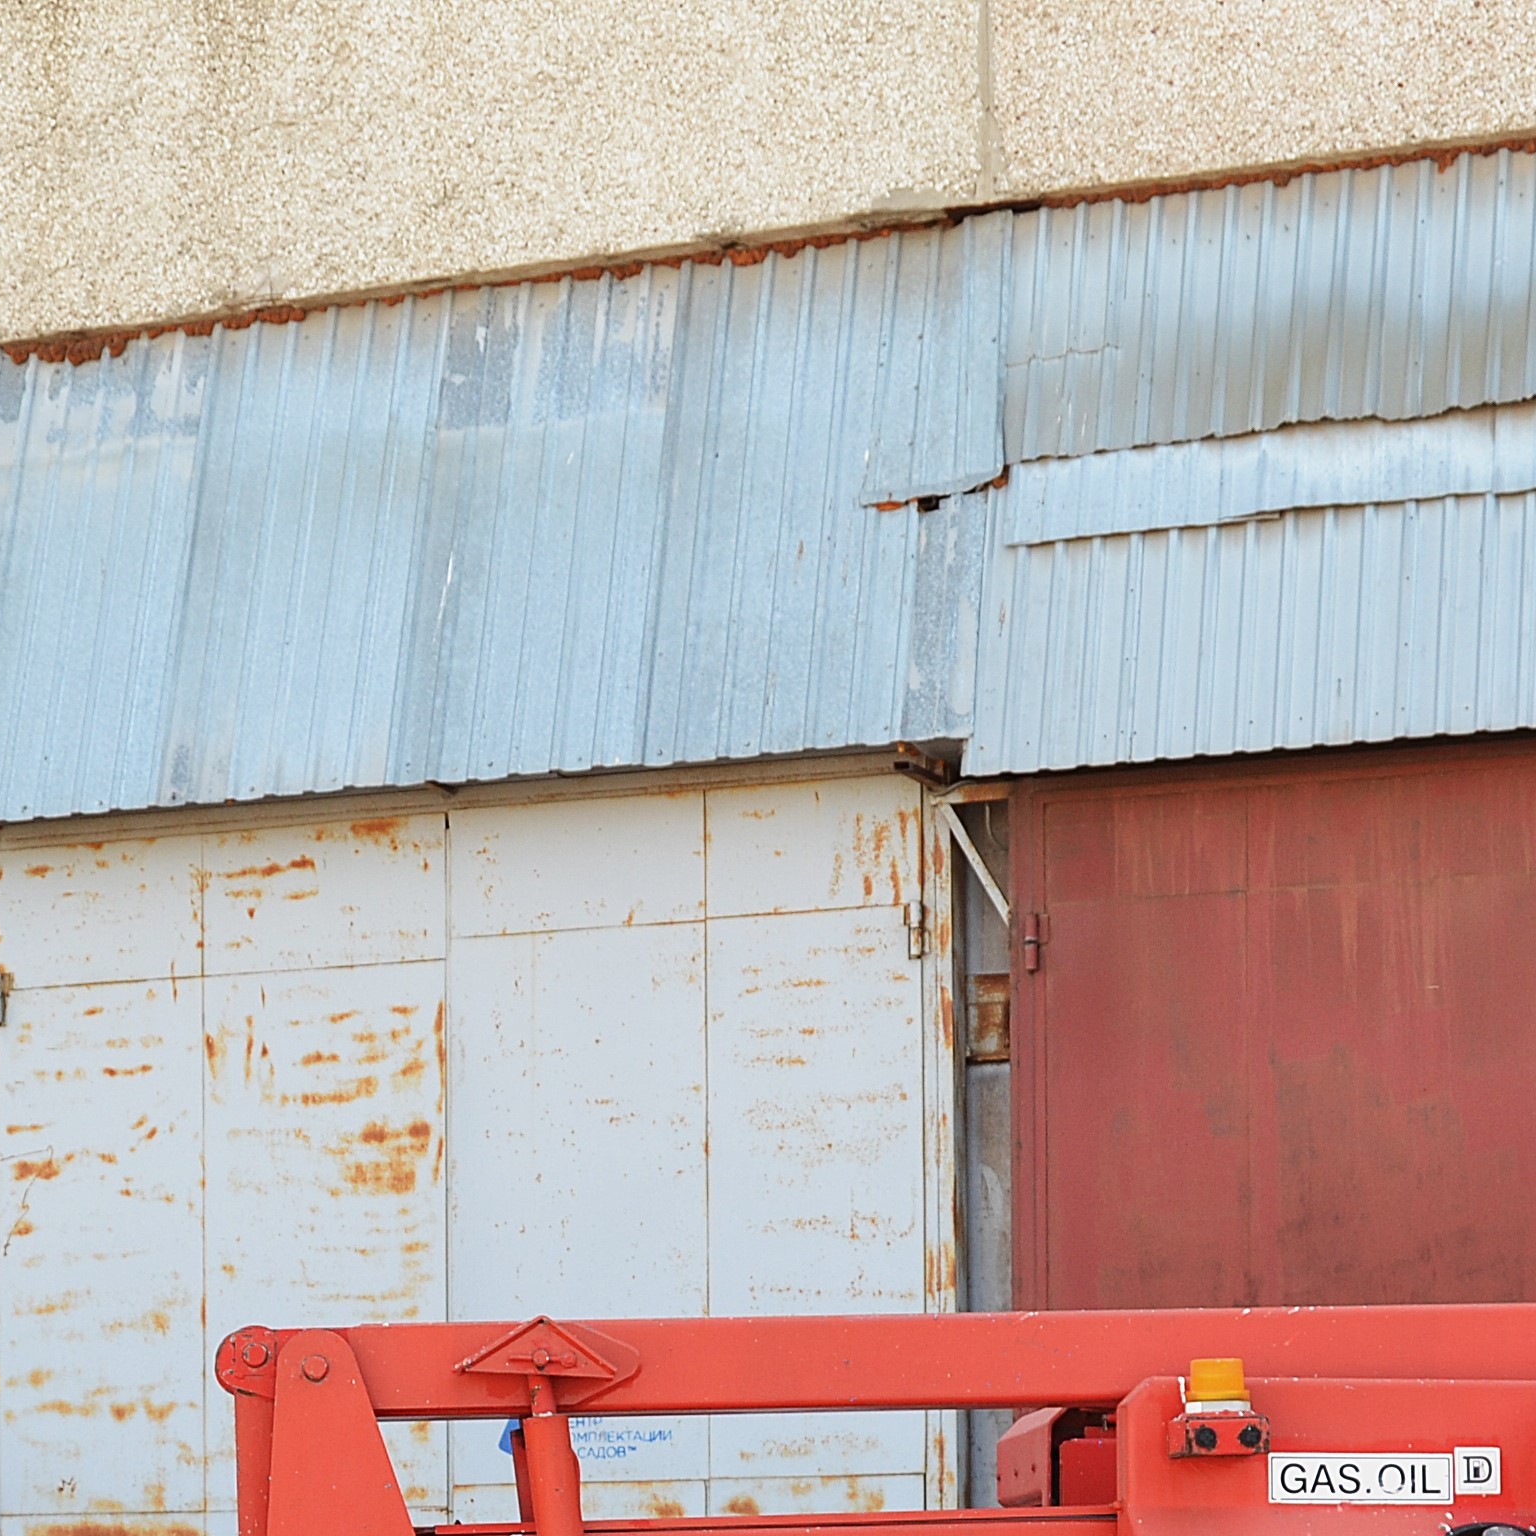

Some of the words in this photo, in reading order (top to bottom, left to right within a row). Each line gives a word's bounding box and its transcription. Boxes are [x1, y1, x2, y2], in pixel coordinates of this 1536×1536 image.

[569, 1417, 603, 1429] ЕНТР
[571, 1429, 672, 1443] МПЛЕКТАЦИИ
[1280, 1463, 1441, 1495] GAS.OIL
[1463, 1456, 1492, 1484] D
